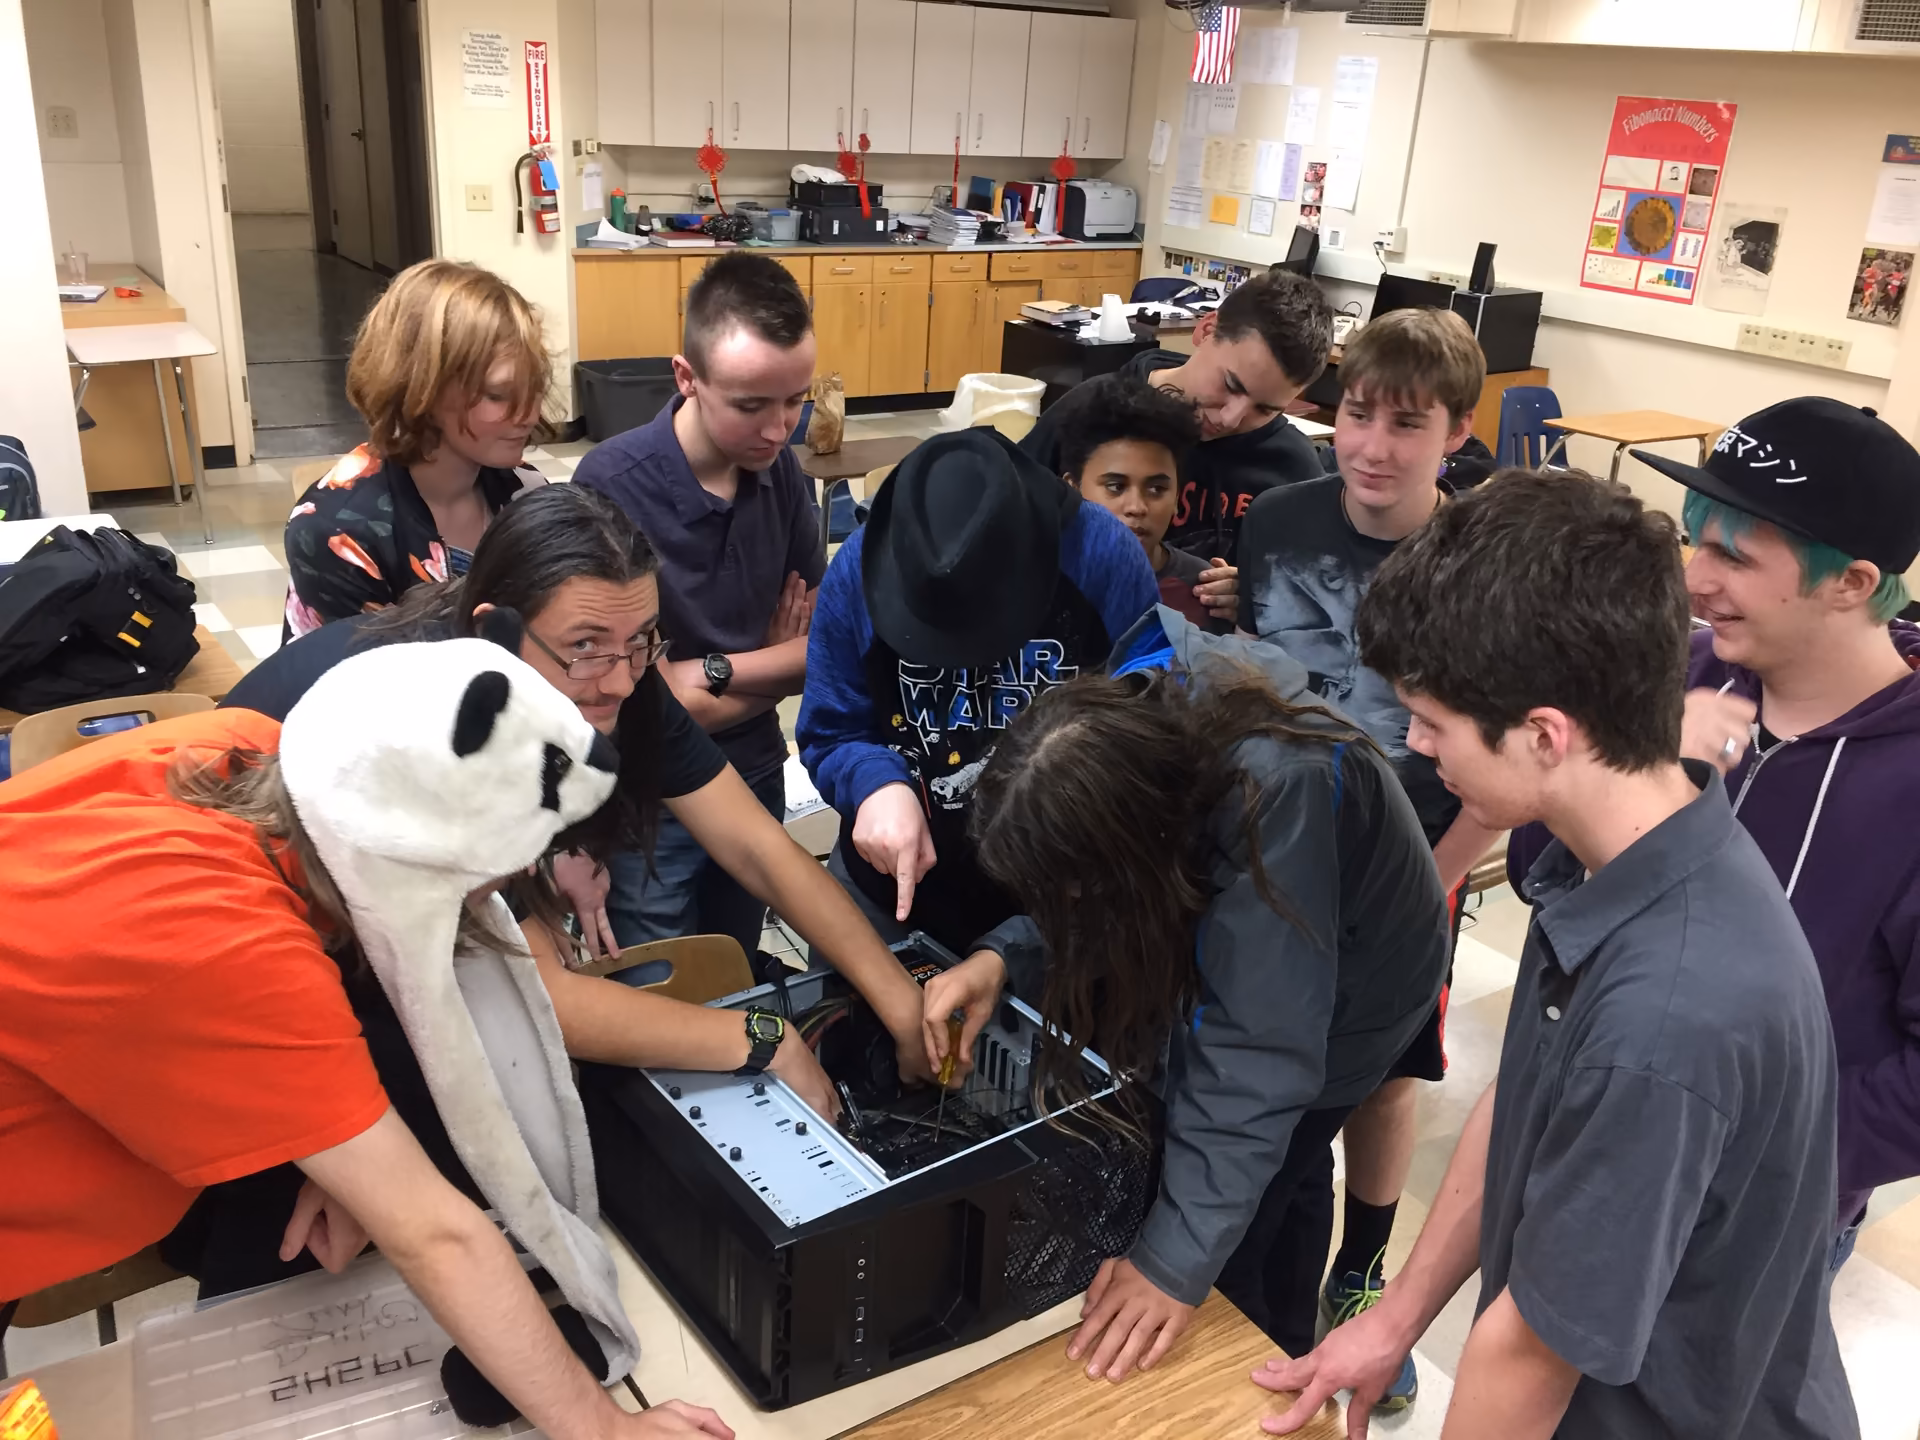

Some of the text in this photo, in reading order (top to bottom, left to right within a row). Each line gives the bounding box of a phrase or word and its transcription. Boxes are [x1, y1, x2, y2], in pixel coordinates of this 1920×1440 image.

[528, 49, 545, 60] FIRE
[1622, 103, 1720, 144] Fibonacci Numbers
